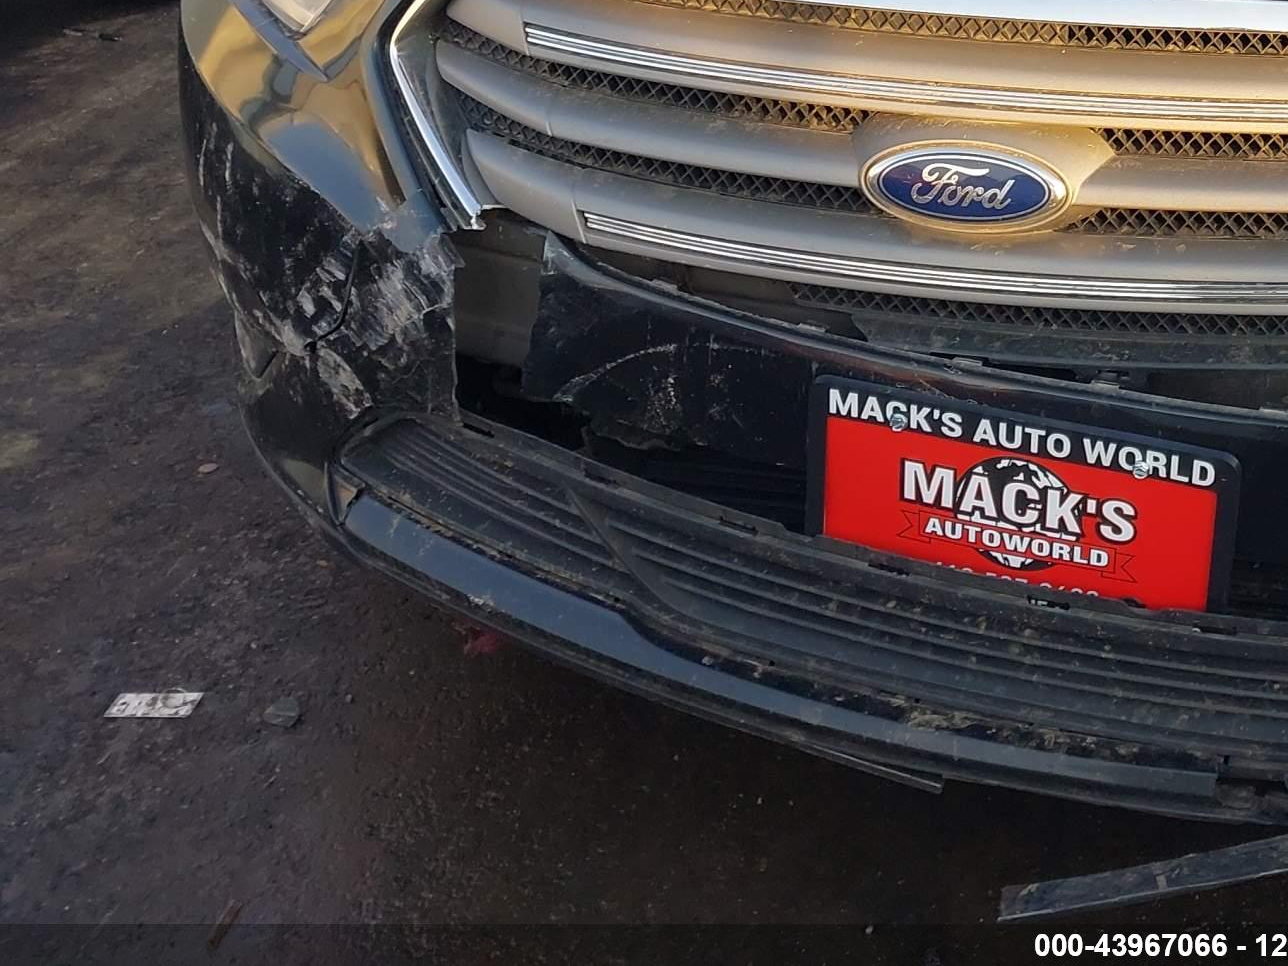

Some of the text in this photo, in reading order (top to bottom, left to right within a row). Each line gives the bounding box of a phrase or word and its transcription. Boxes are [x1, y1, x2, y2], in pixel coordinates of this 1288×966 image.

[910, 162, 1016, 210] Ford
[829, 387, 1216, 487] MACK'S AUTO WORLD
[902, 460, 1137, 543] MACK'S
[924, 517, 1110, 568] AUTOWORLD
